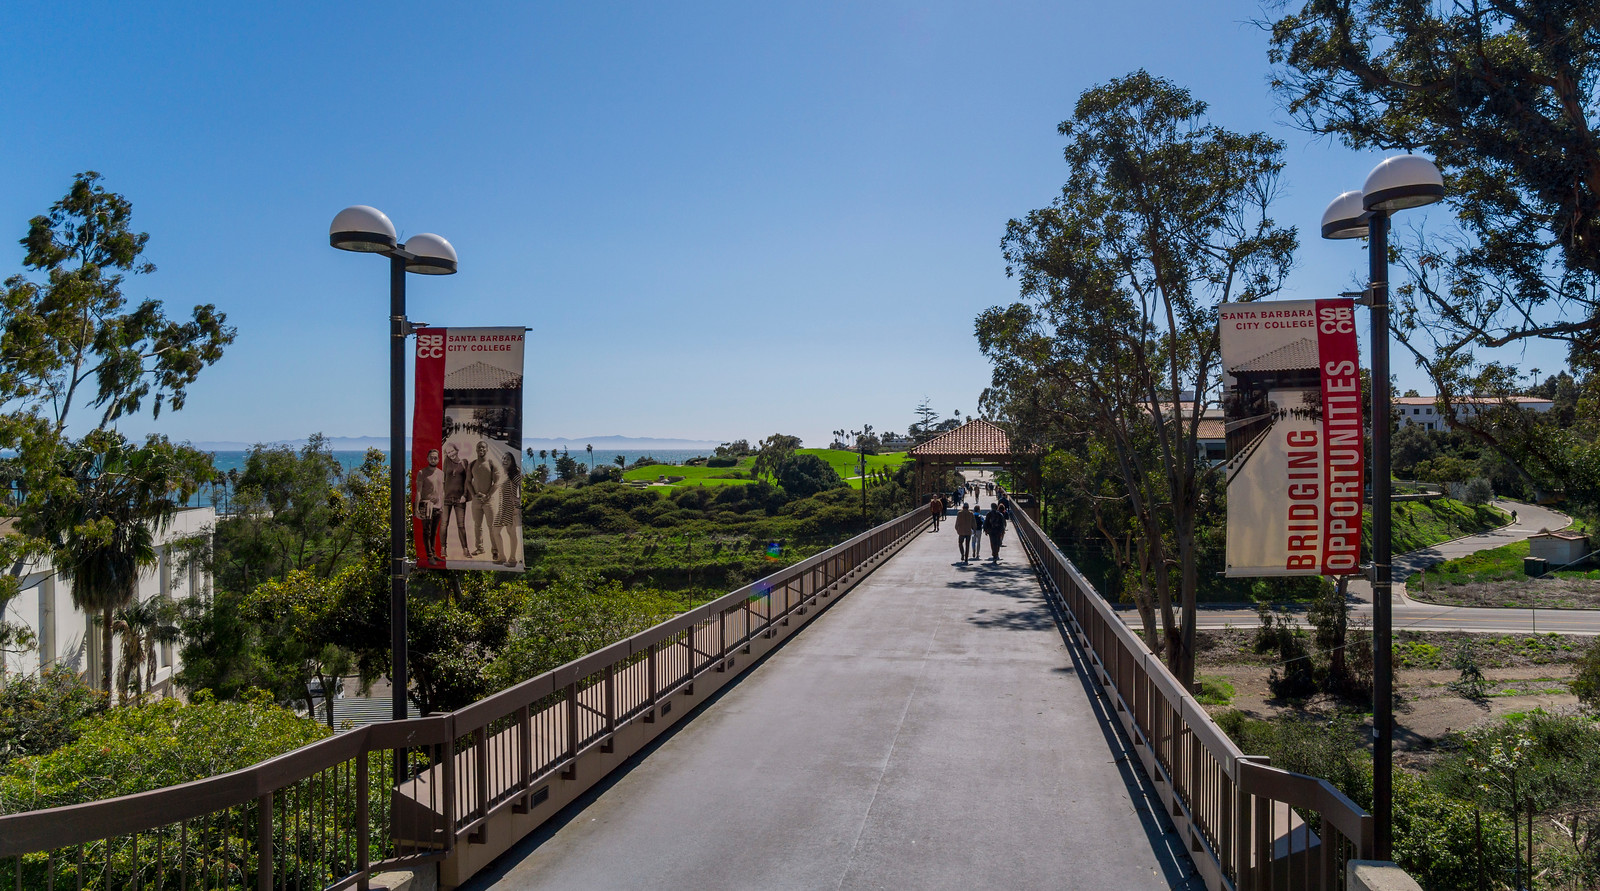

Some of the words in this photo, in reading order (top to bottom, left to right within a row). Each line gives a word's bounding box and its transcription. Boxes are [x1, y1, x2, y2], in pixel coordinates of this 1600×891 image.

[1222, 311, 1257, 320] SANTA
[1261, 309, 1314, 319] BARBARA
[1320, 307, 1352, 320] SB
[1236, 322, 1260, 331] CITY
[1264, 320, 1315, 330] COLLEGE
[1320, 320, 1353, 335] CC
[417, 334, 444, 347] SB
[417, 346, 444, 359] CC
[470, 344, 512, 352] COLLEGE
[1325, 360, 1360, 570] OPPORTUNITIES
[1286, 430, 1319, 570] BRIDGING
